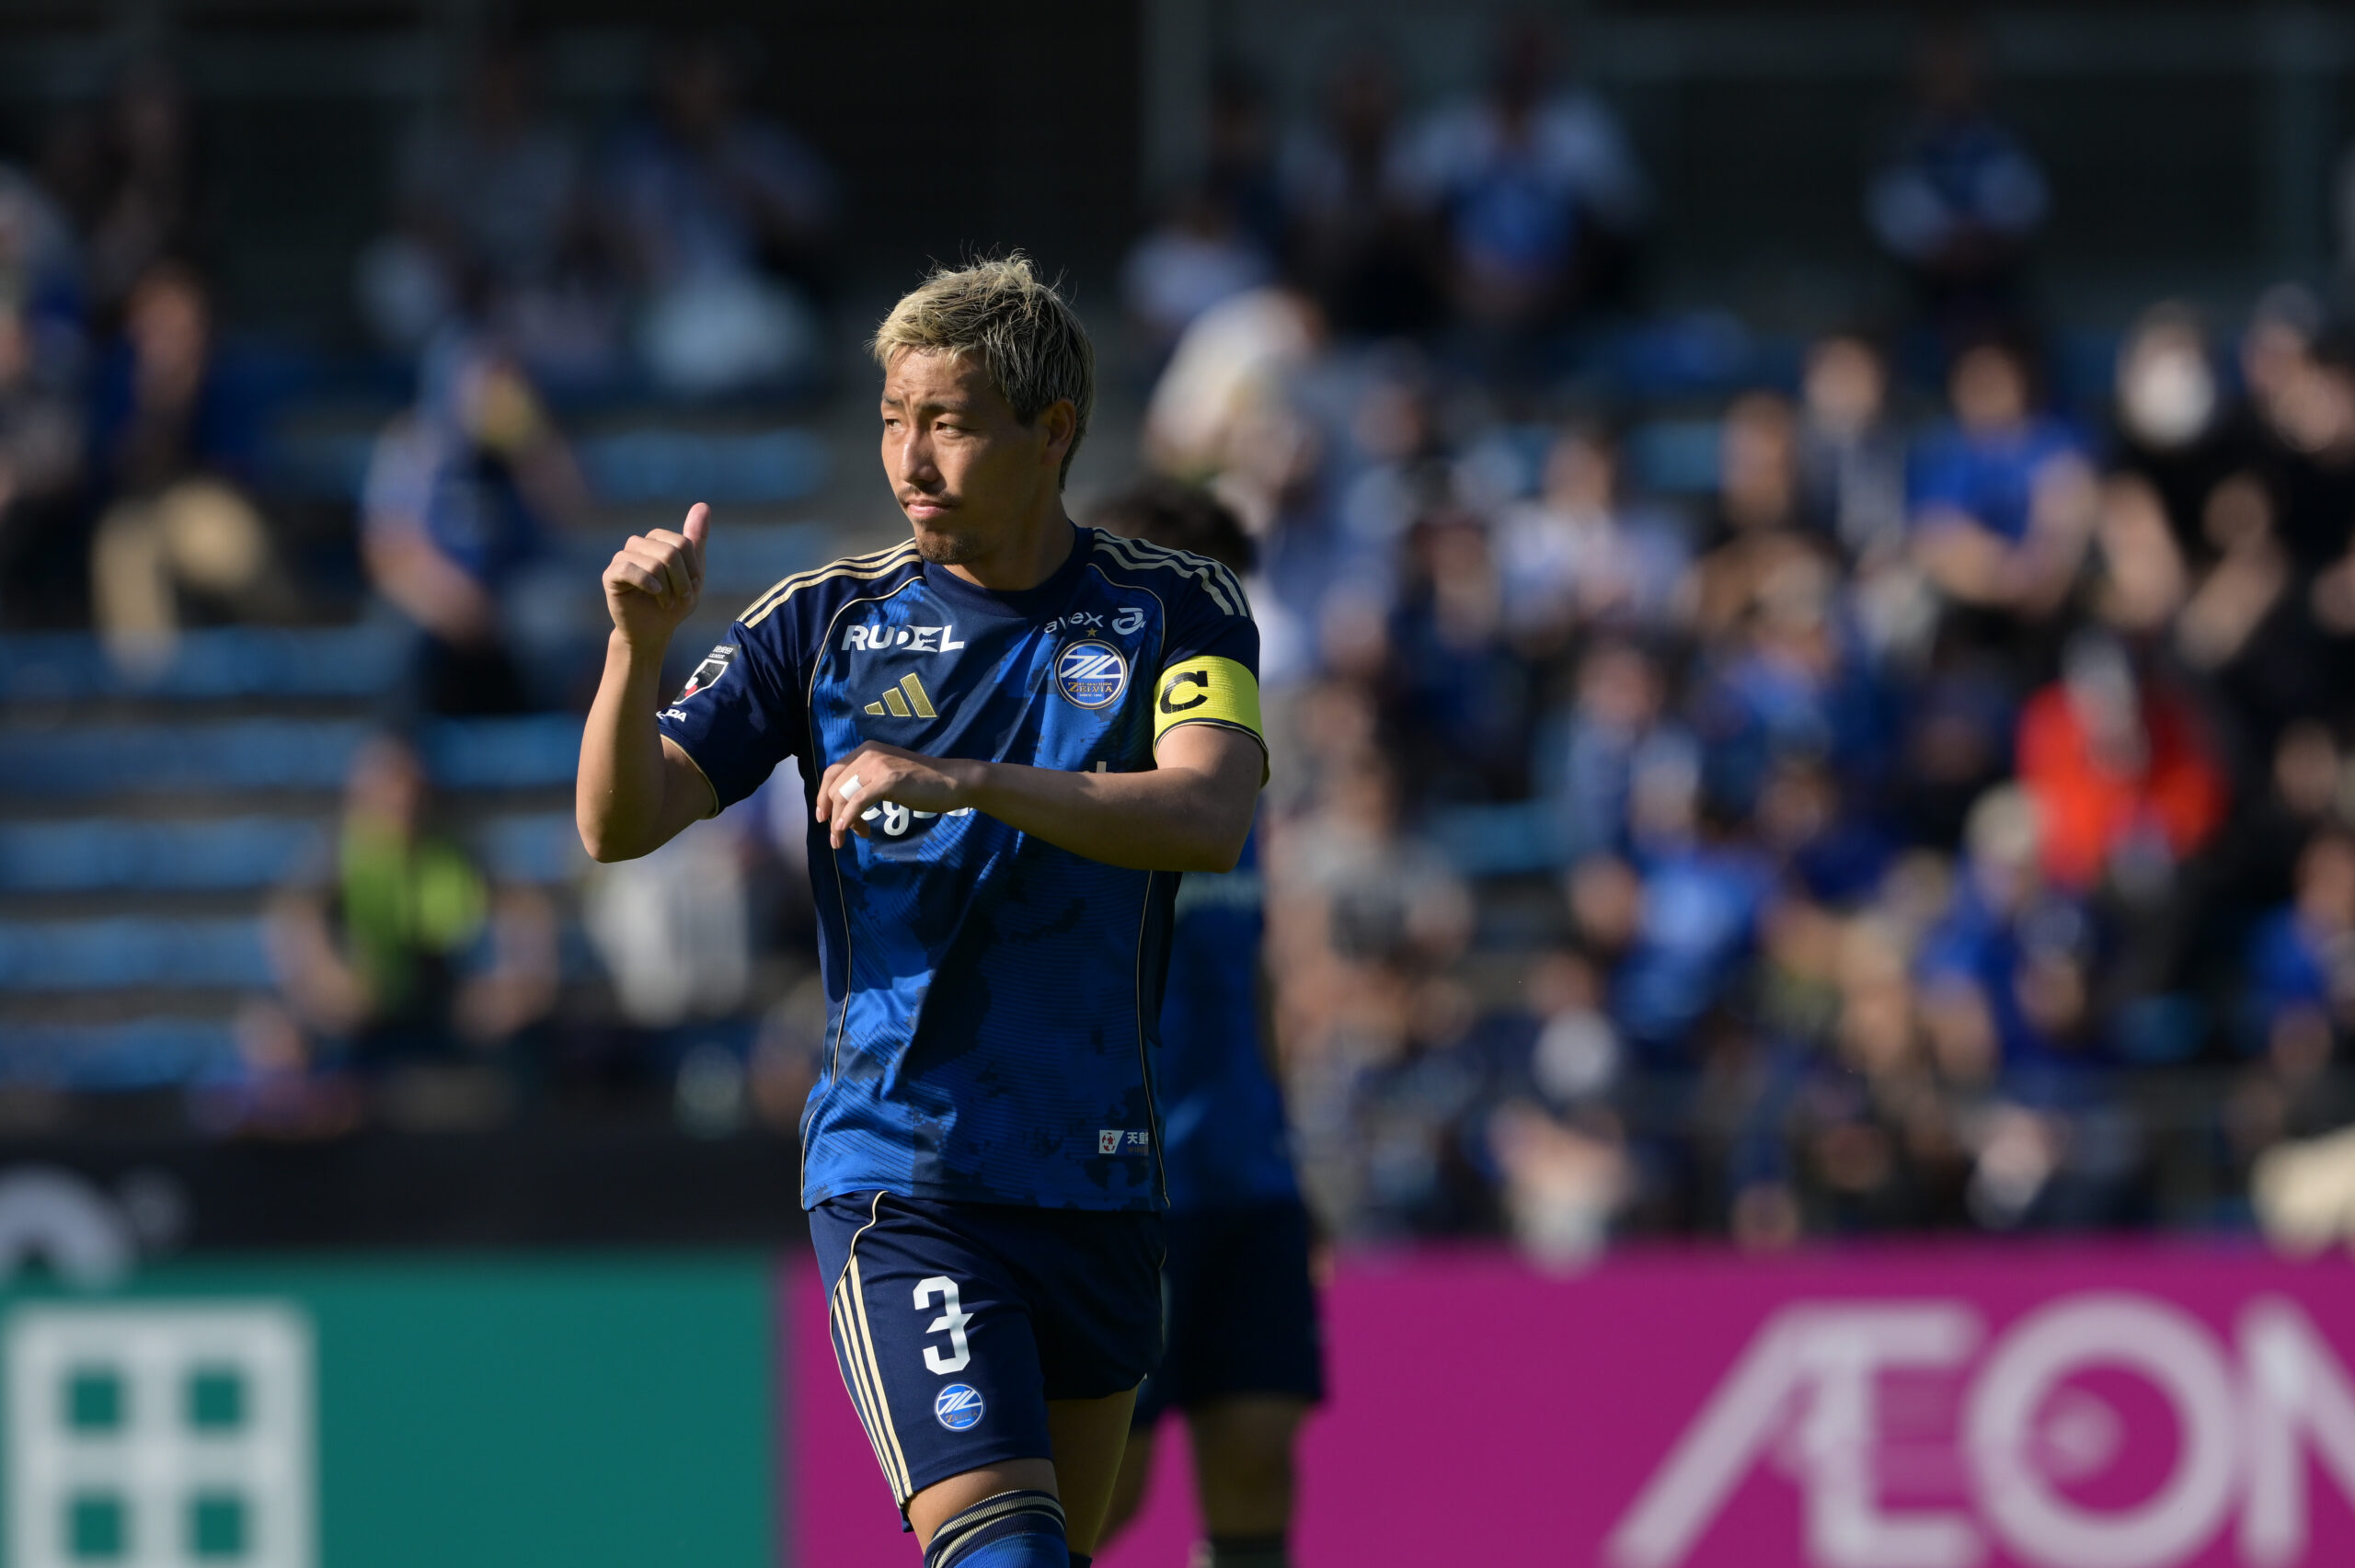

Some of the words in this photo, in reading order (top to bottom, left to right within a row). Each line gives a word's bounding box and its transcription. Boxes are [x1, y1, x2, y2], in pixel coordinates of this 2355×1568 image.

[841, 624, 965, 653] RUDEL
[1043, 612, 1104, 634] avex
[1160, 670, 1209, 715] C
[913, 1276, 974, 1376] 3
